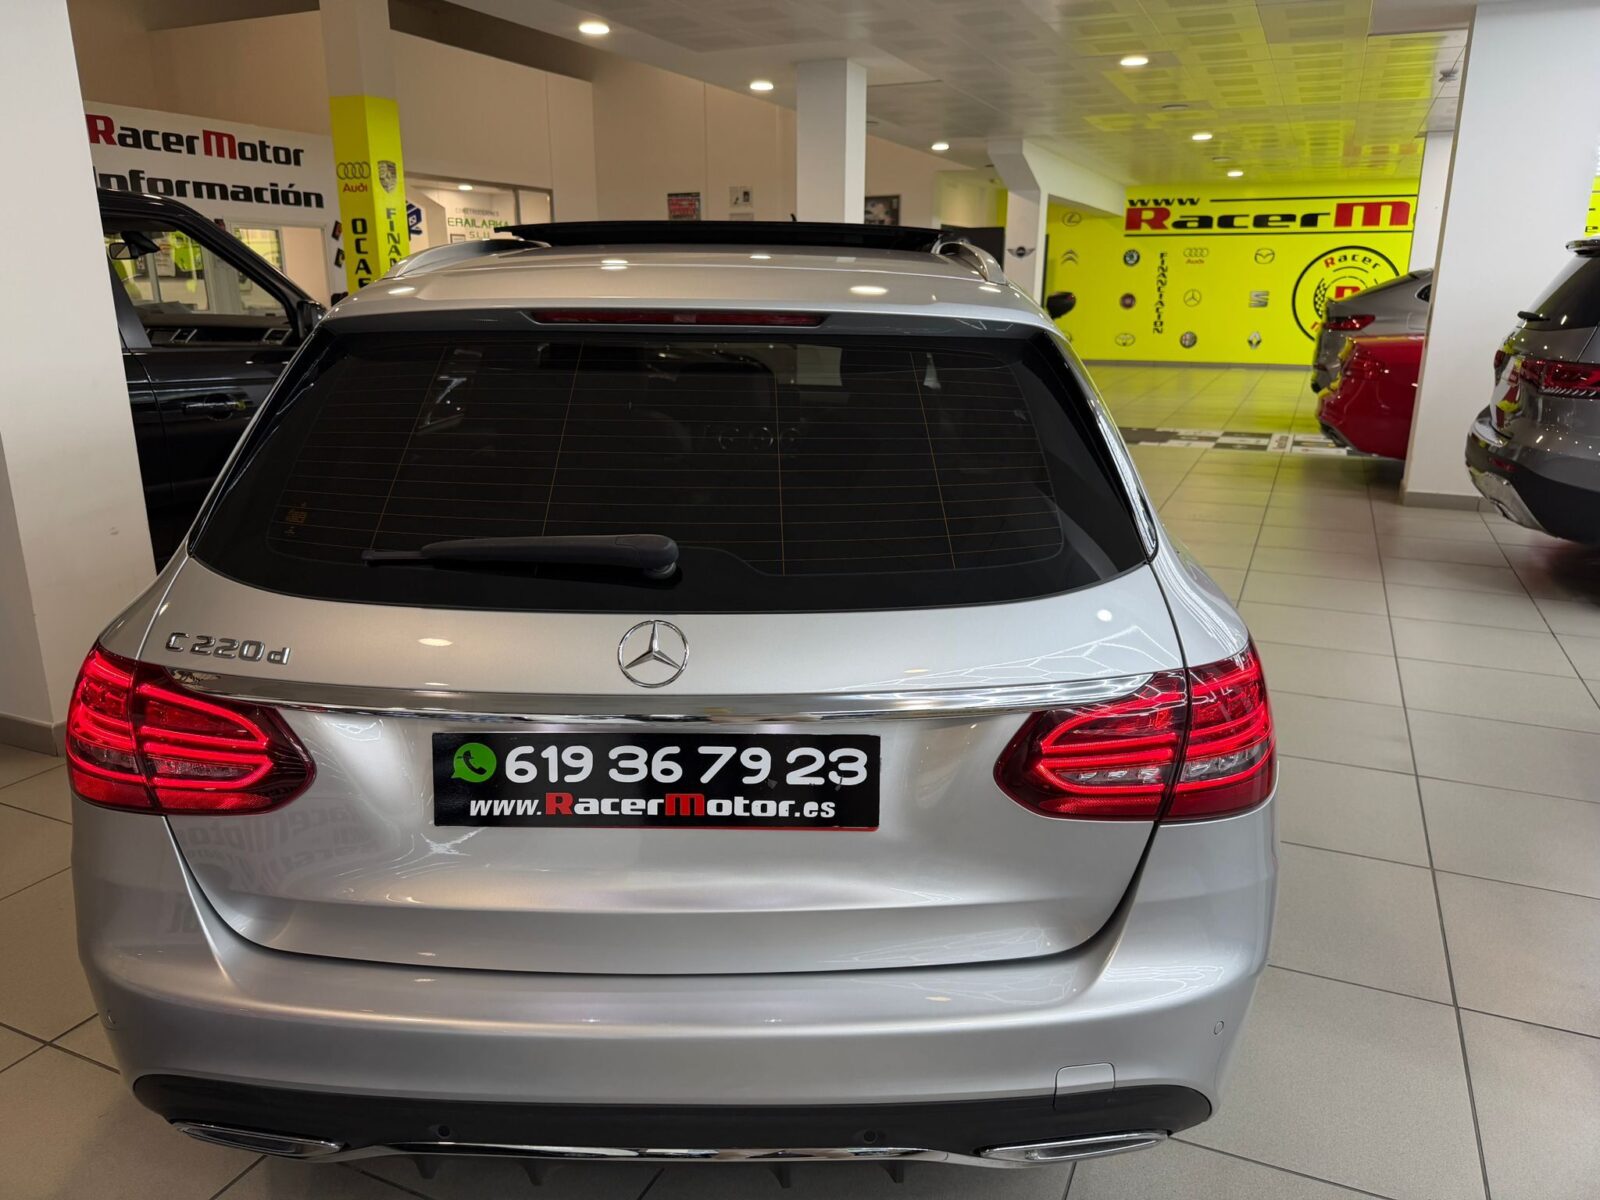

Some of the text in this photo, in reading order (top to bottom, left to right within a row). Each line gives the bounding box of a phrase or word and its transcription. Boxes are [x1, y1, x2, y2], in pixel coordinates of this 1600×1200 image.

[86, 114, 304, 166] RacerMotor
[93, 166, 324, 208] nformación
[343, 183, 368, 193] Audi
[1125, 201, 1415, 231] RacerM
[1324, 254, 1381, 269] Racer
[505, 745, 868, 785] 619 36 79 23
[469, 792, 836, 818] www.RacerMotor.es
